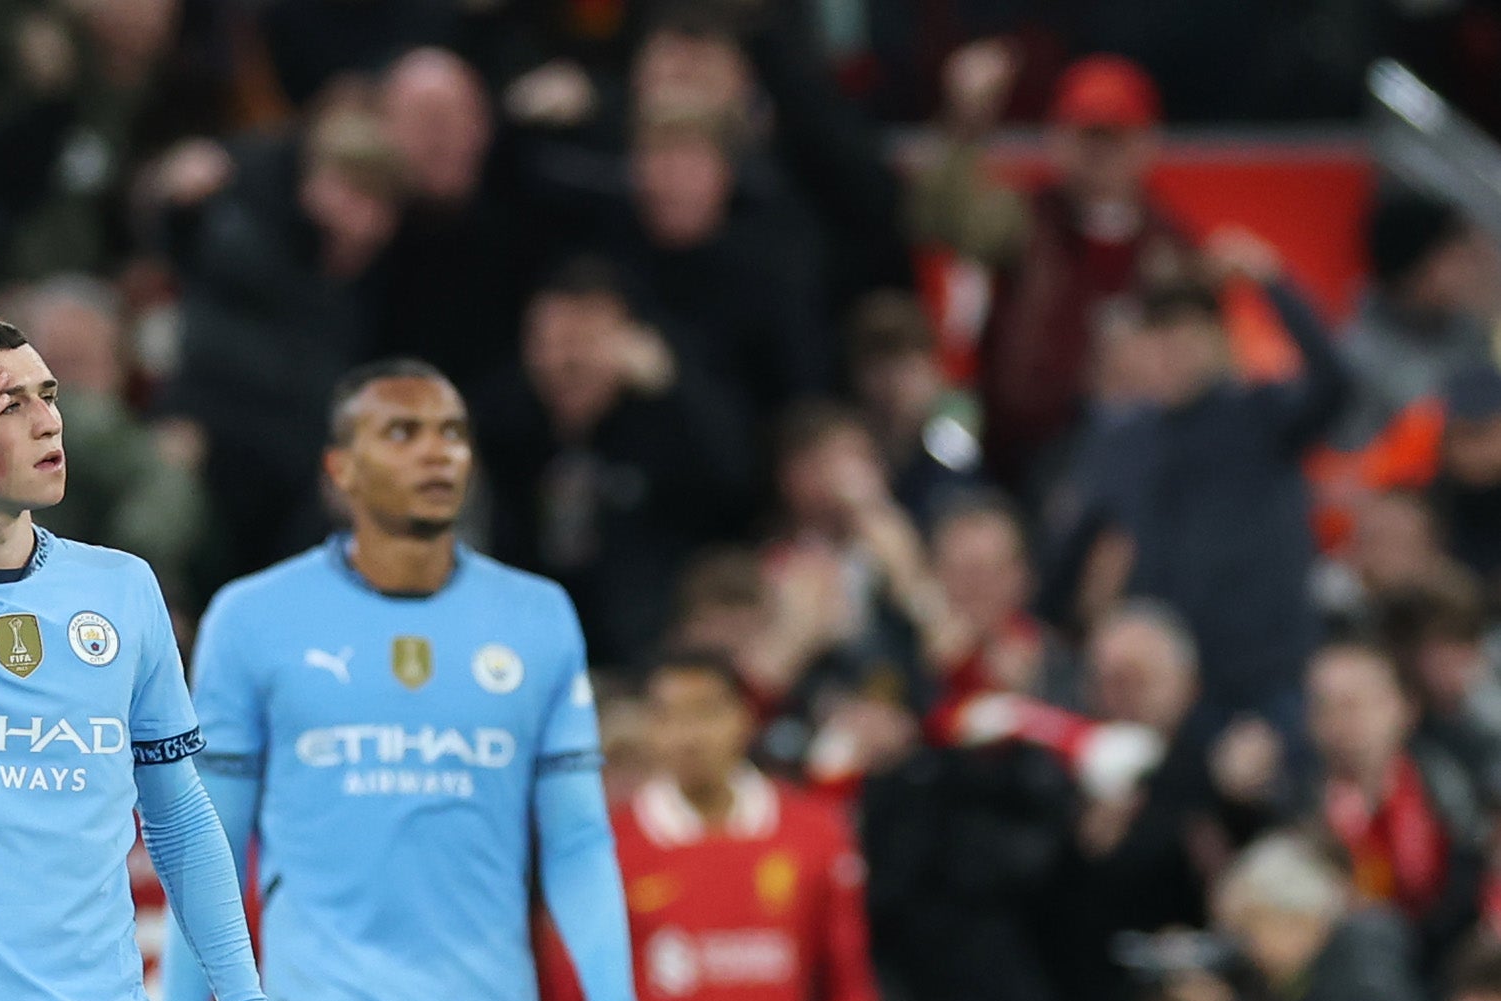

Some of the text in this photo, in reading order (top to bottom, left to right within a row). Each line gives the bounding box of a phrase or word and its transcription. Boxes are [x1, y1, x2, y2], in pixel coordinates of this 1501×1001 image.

[71, 615, 112, 632] MANCHESTER
[9, 654, 33, 664] FIFA
[296, 724, 516, 768] ETIHAD
[344, 769, 473, 798] AIRWAYS
